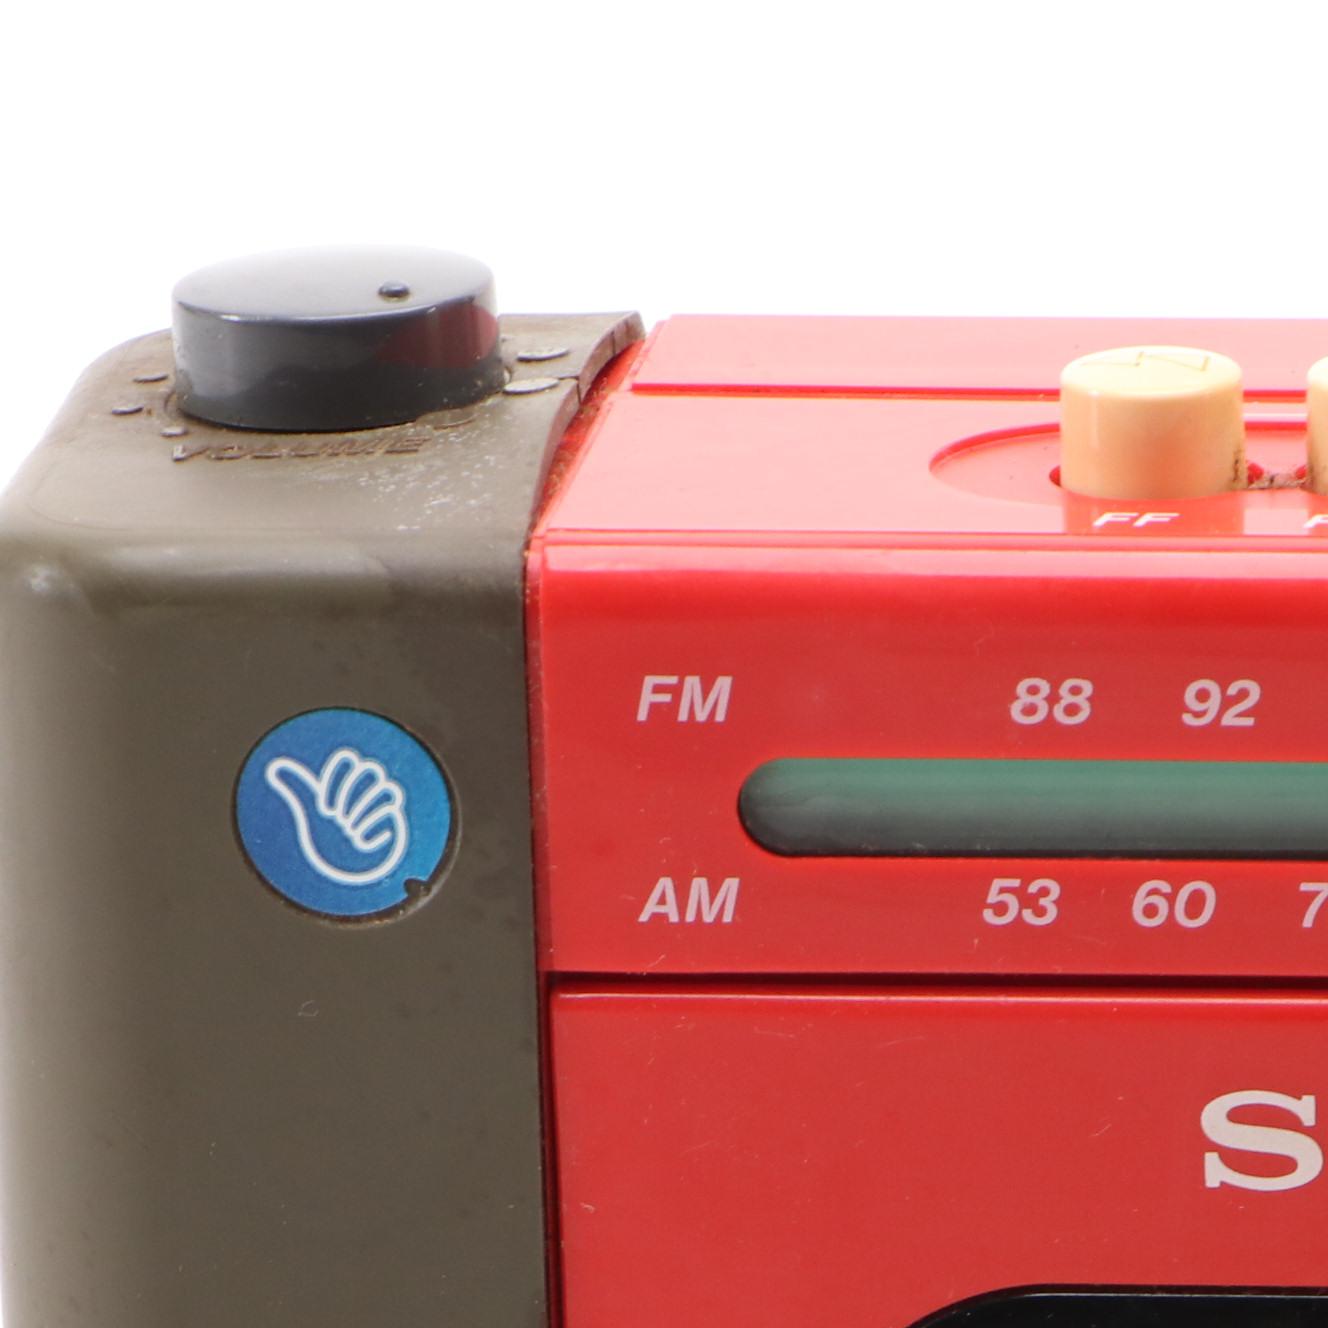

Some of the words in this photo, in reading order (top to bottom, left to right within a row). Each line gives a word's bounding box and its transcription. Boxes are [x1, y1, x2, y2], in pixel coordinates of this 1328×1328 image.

[1093, 511, 1180, 527] FF
[637, 676, 733, 722] FM
[1009, 678, 1094, 725] 88
[1181, 680, 1261, 727] 92
[638, 877, 740, 924] AM
[982, 879, 1061, 926] 53
[1131, 880, 1217, 929] 60
